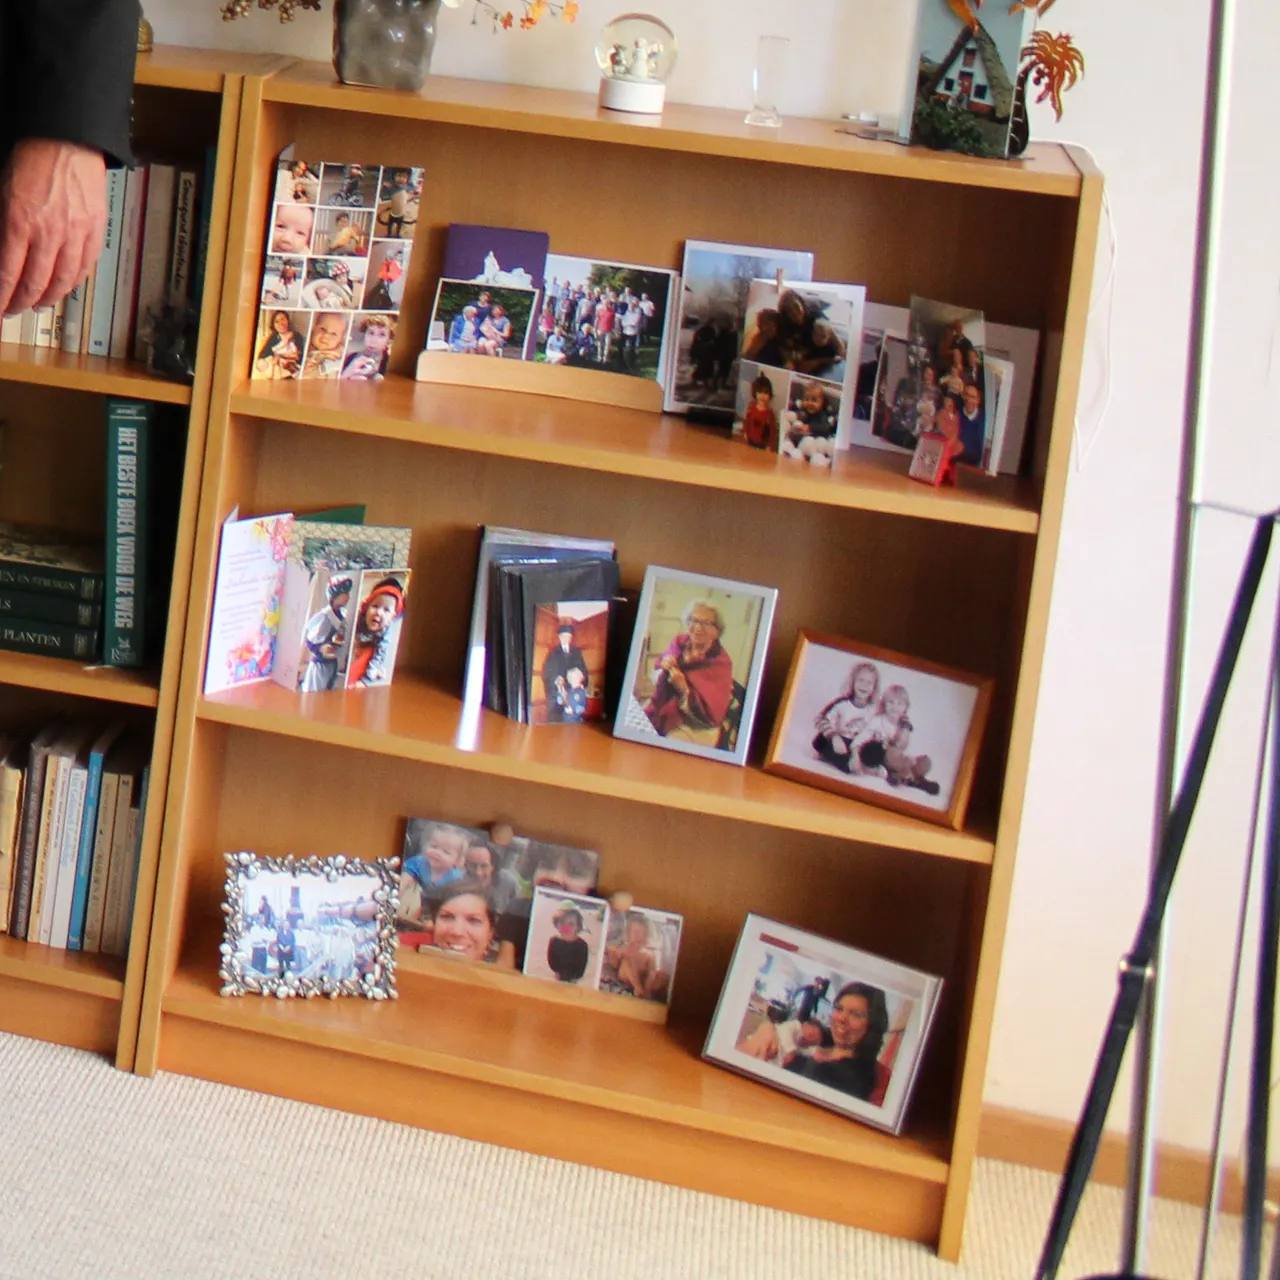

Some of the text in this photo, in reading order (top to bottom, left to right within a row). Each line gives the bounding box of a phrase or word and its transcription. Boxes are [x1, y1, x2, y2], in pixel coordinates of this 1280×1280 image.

[117, 426, 137, 453] HET
[117, 454, 137, 497] BESTE
[116, 497, 136, 535] BOEK
[116, 536, 135, 575] VOOR
[115, 576, 135, 594] DE
[114, 596, 133, 628] WEG
[4, 628, 60, 647] PLANTEN
